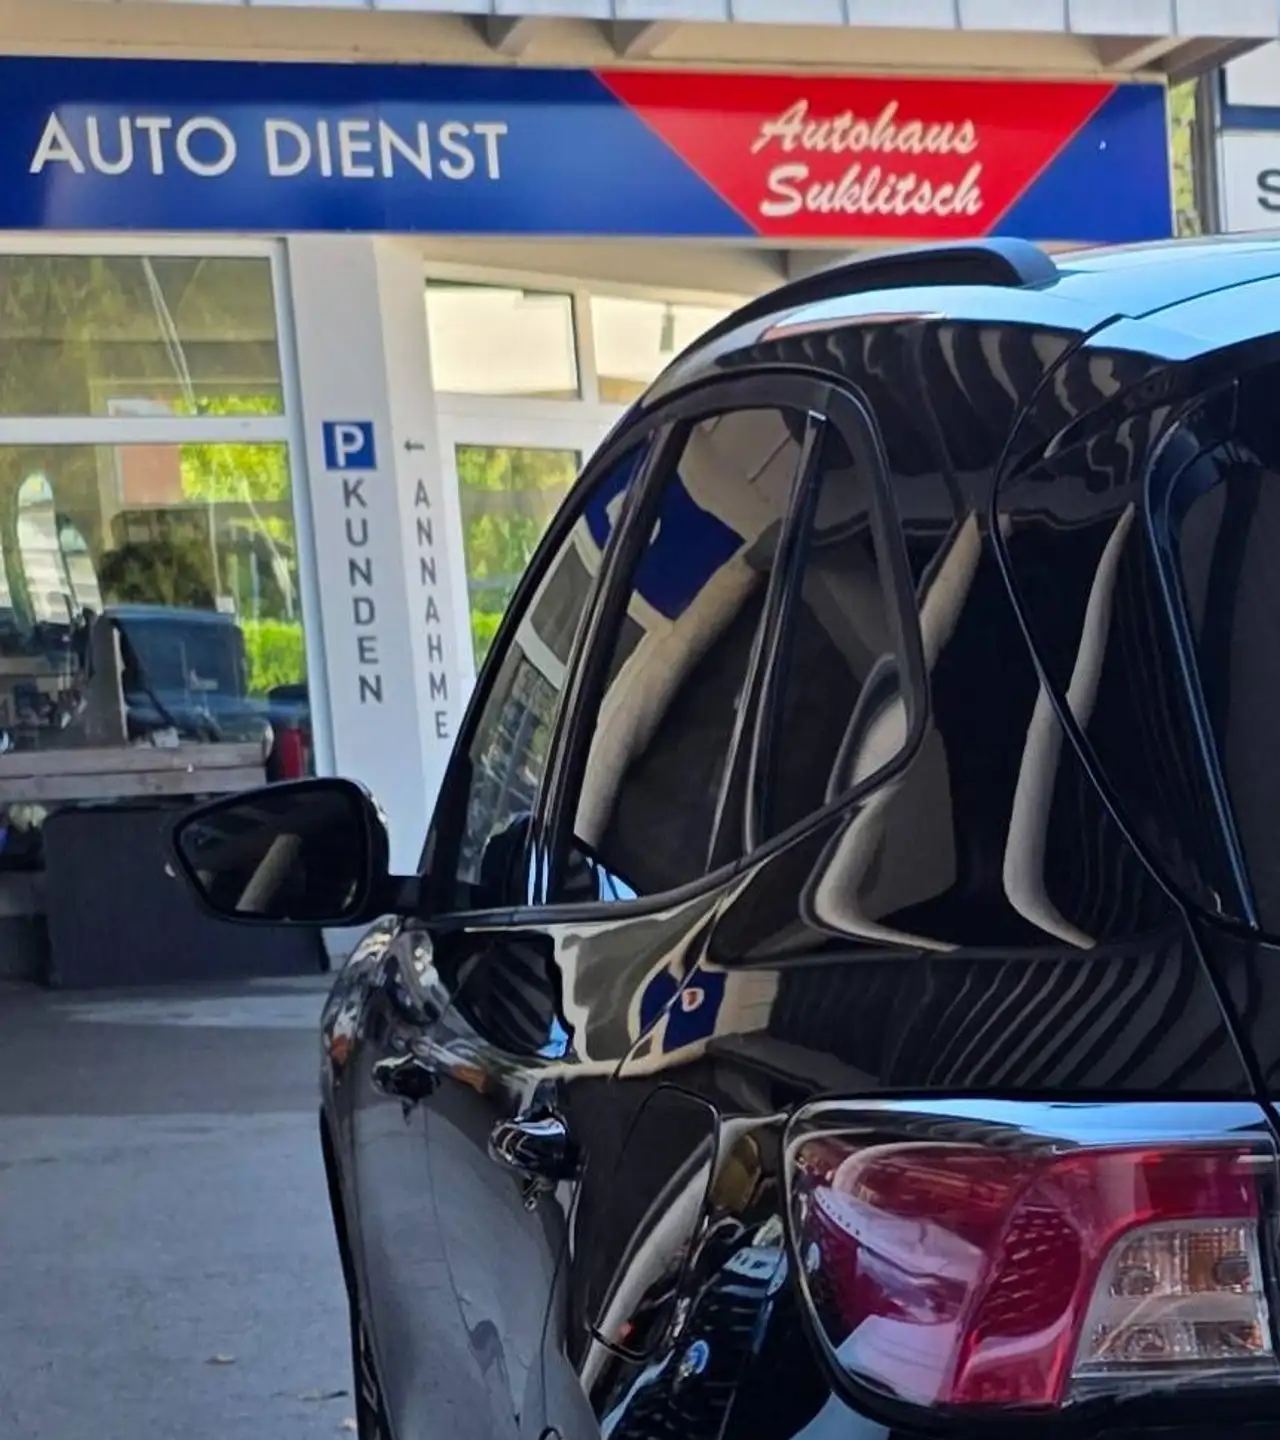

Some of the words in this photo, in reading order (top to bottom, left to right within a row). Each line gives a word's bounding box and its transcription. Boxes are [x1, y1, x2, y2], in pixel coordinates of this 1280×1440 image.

[29, 111, 237, 176] AUTO
[265, 119, 508, 181] DIENST
[750, 97, 979, 155] Autohaus
[759, 160, 984, 217] Suklitsch
[334, 424, 366, 469] P
[342, 478, 383, 704] KUNDEN
[414, 478, 451, 740] ANNAHME
